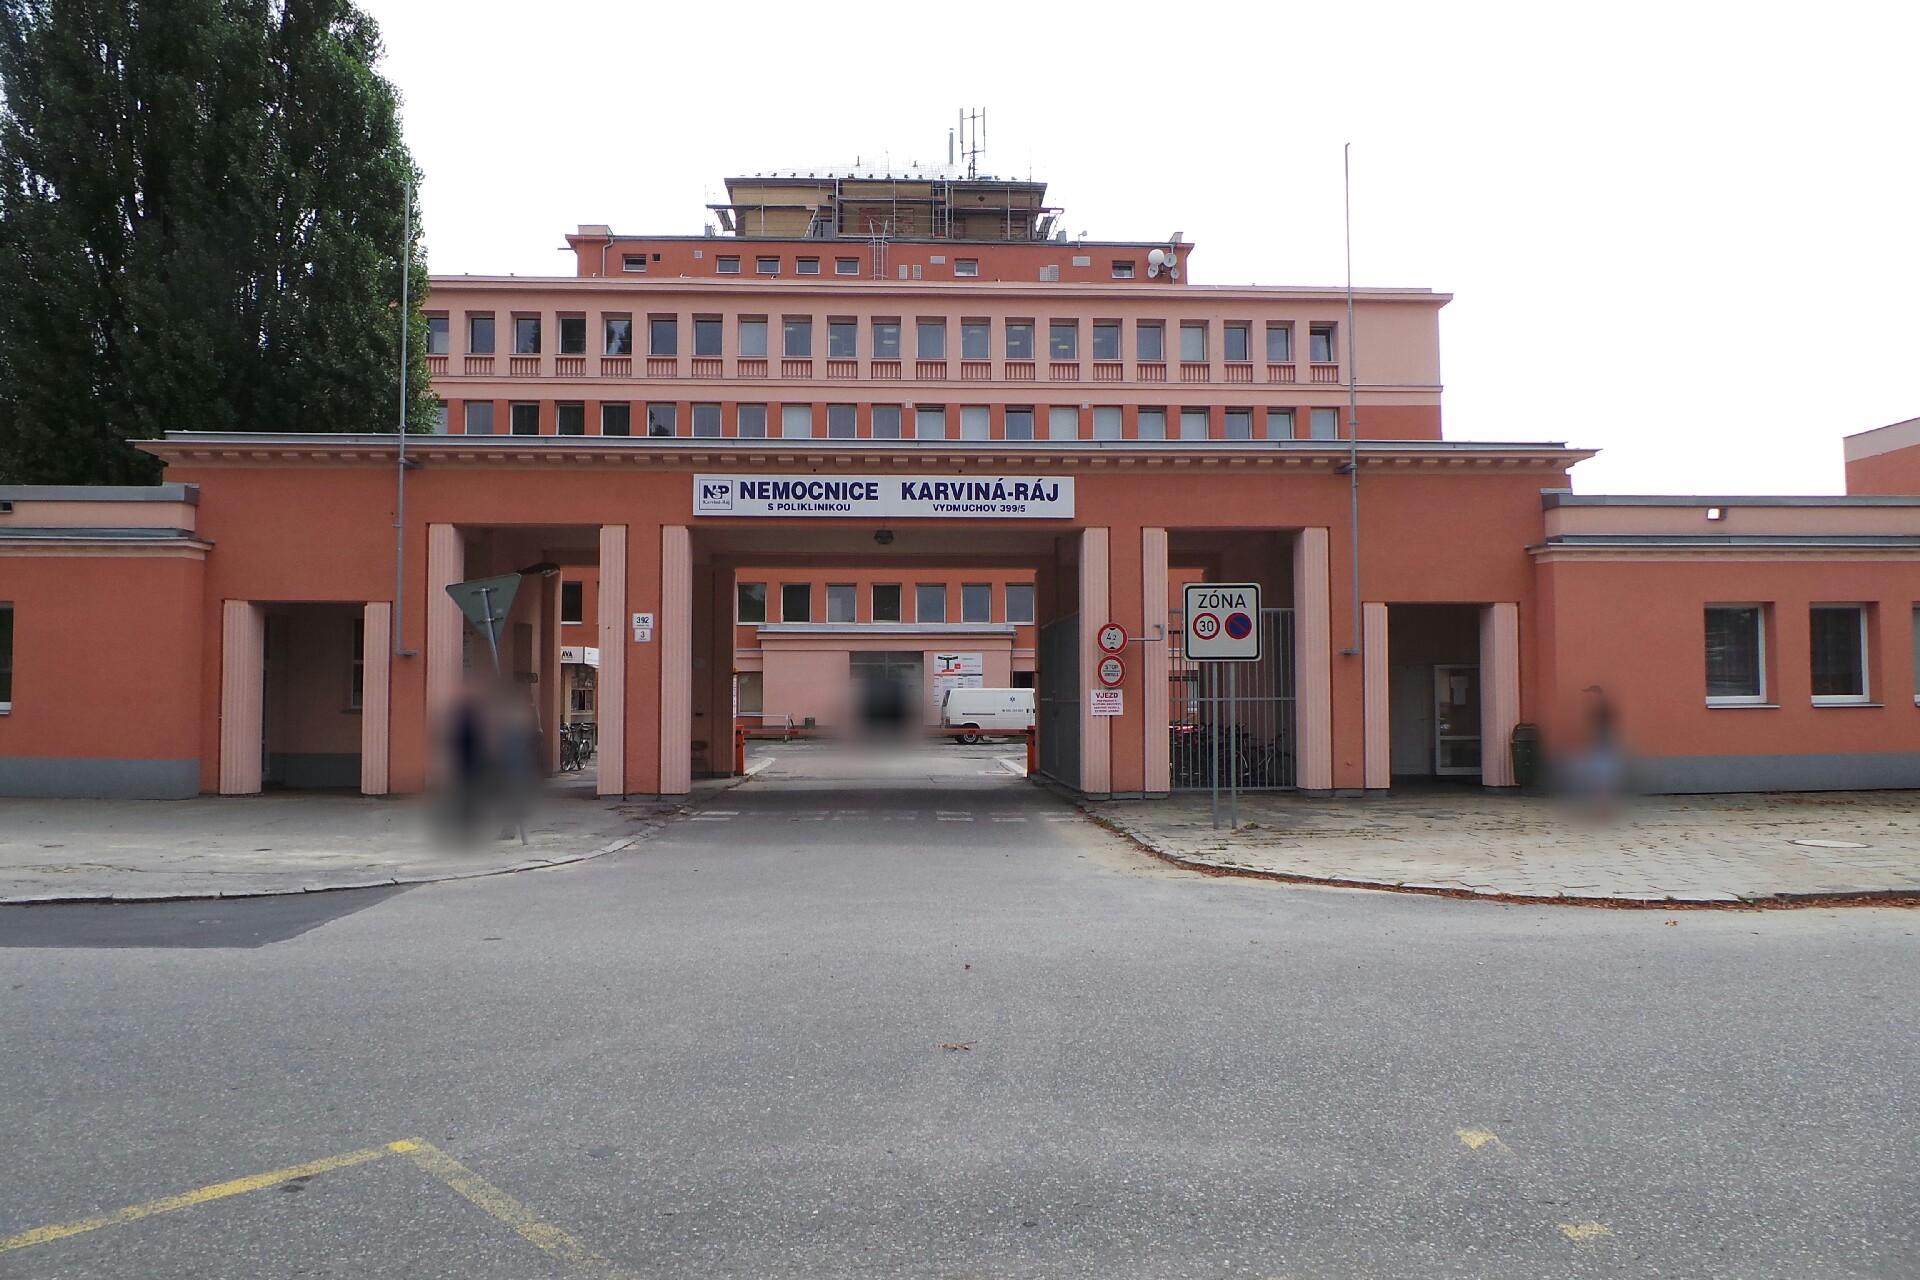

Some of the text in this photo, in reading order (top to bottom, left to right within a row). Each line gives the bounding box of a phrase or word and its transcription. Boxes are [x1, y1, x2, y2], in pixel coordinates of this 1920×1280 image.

[740, 478, 1059, 502] NEMOCNICE KARVINÁ-RÁJ
[767, 503, 851, 511] S POLIKLINIKOU
[932, 504, 1026, 513] VYDMUCHOV 399/5
[1198, 590, 1247, 609] ZÓNA
[1199, 620, 1214, 632] 30
